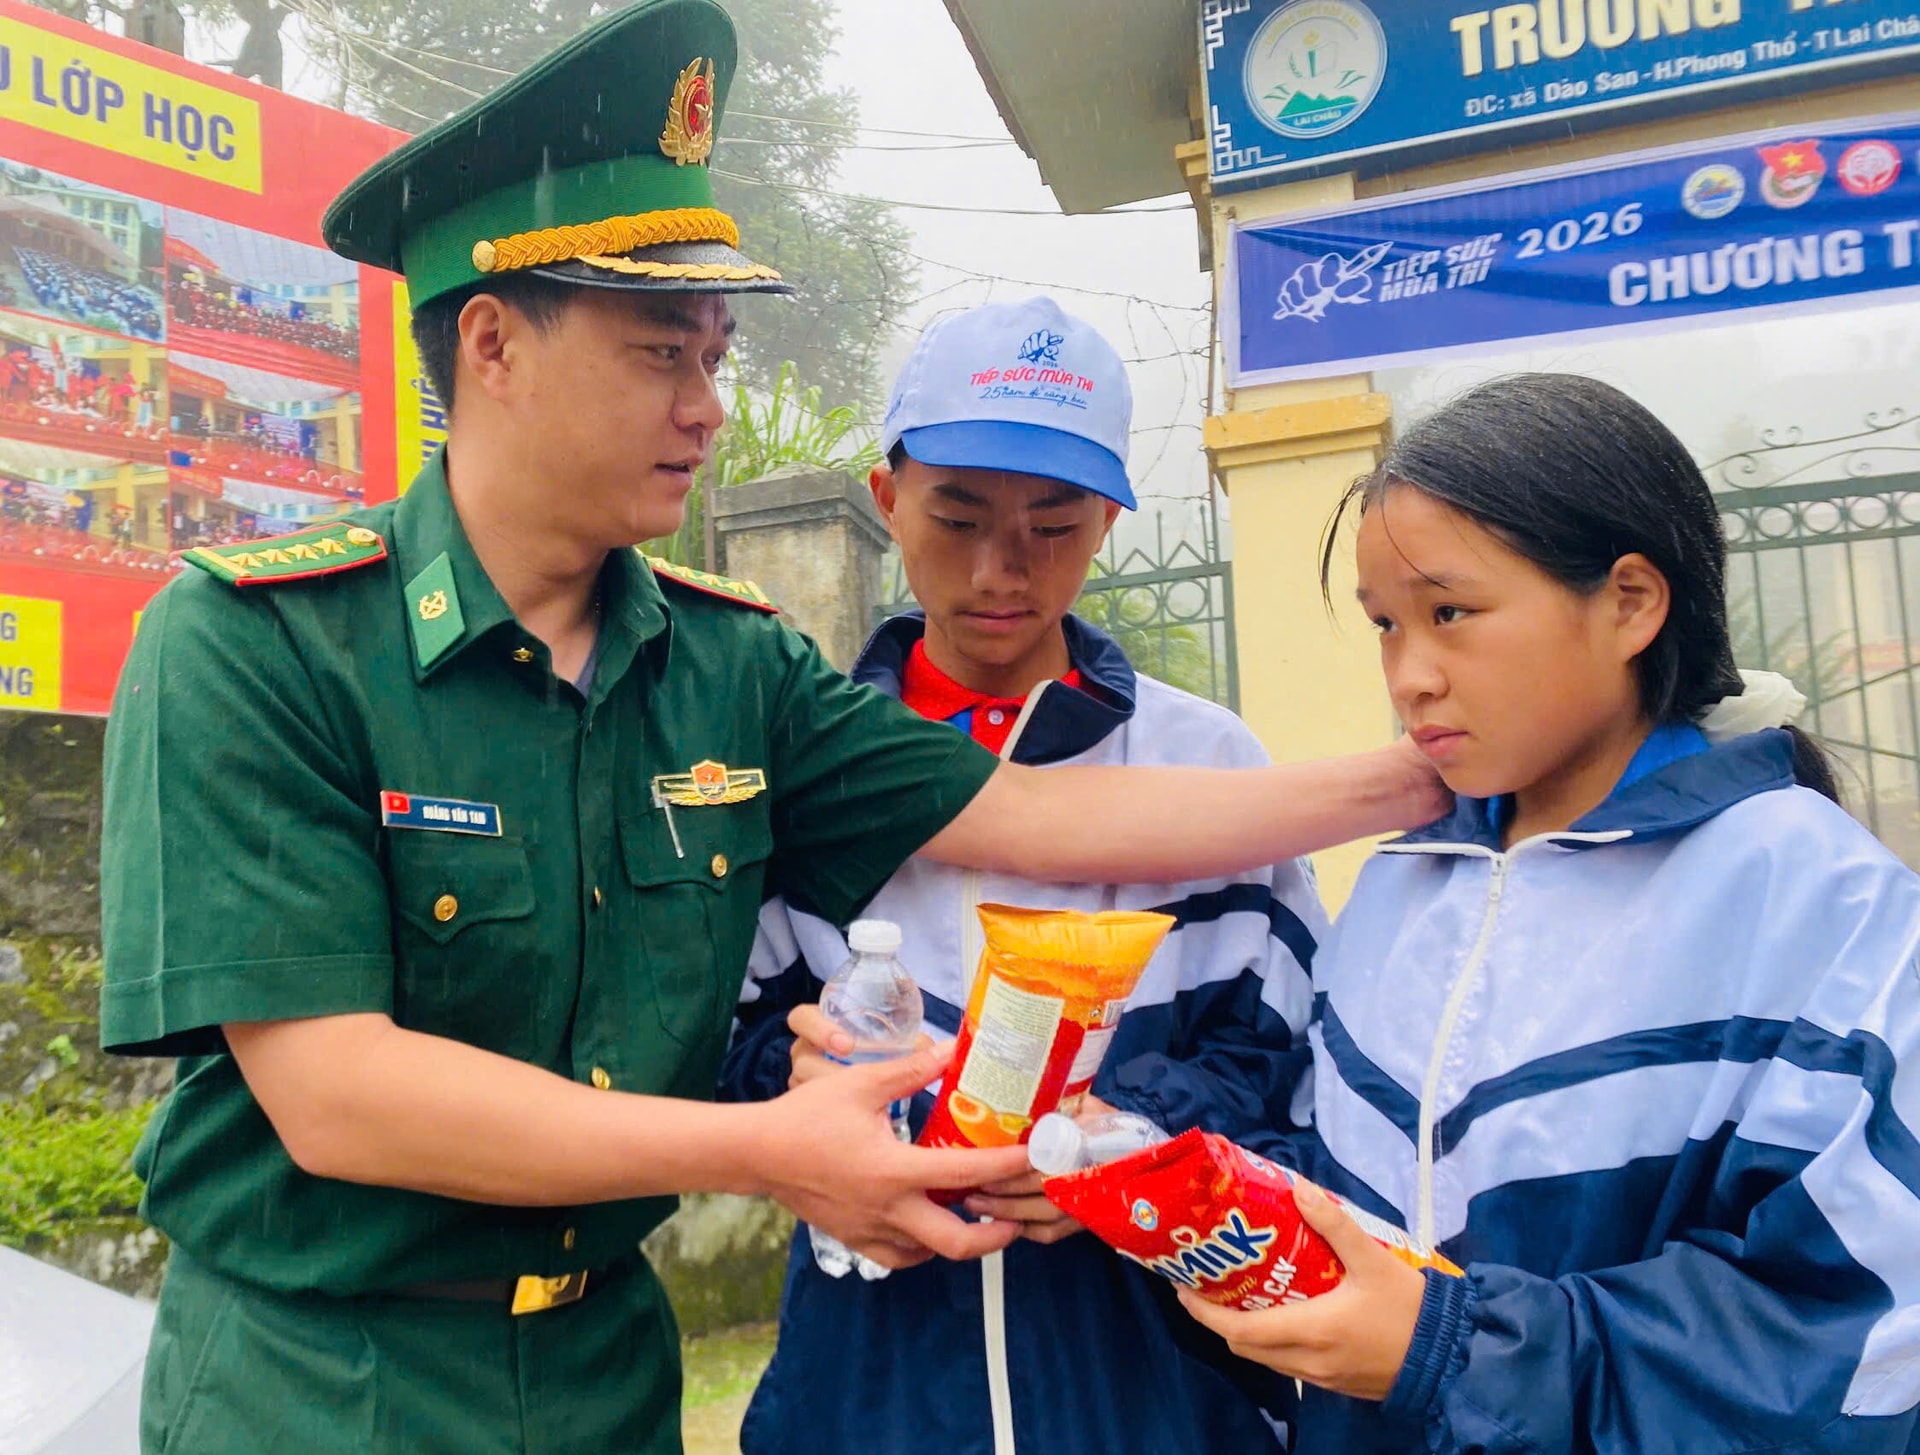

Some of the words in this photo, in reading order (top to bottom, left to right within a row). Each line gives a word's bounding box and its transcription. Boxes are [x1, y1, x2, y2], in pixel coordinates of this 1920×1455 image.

[31, 54, 124, 124] LỚP
[143, 91, 235, 161] HỌC
[1465, 95, 1505, 117] ĐC:
[1510, 86, 1538, 109] xã
[1595, 69, 1638, 92] San
[1516, 202, 1643, 260] 2026
[1446, 257, 1493, 290] THI
[1608, 228, 1864, 307] CHƯƠNG
[1882, 219, 1920, 269] T
[970, 366, 1000, 385] TIẾP
[1001, 365, 1036, 382] SỨC
[1037, 368, 1074, 386] MÙA
[1076, 376, 1094, 392] THI
[1263, 1255, 1297, 1296] CAY
